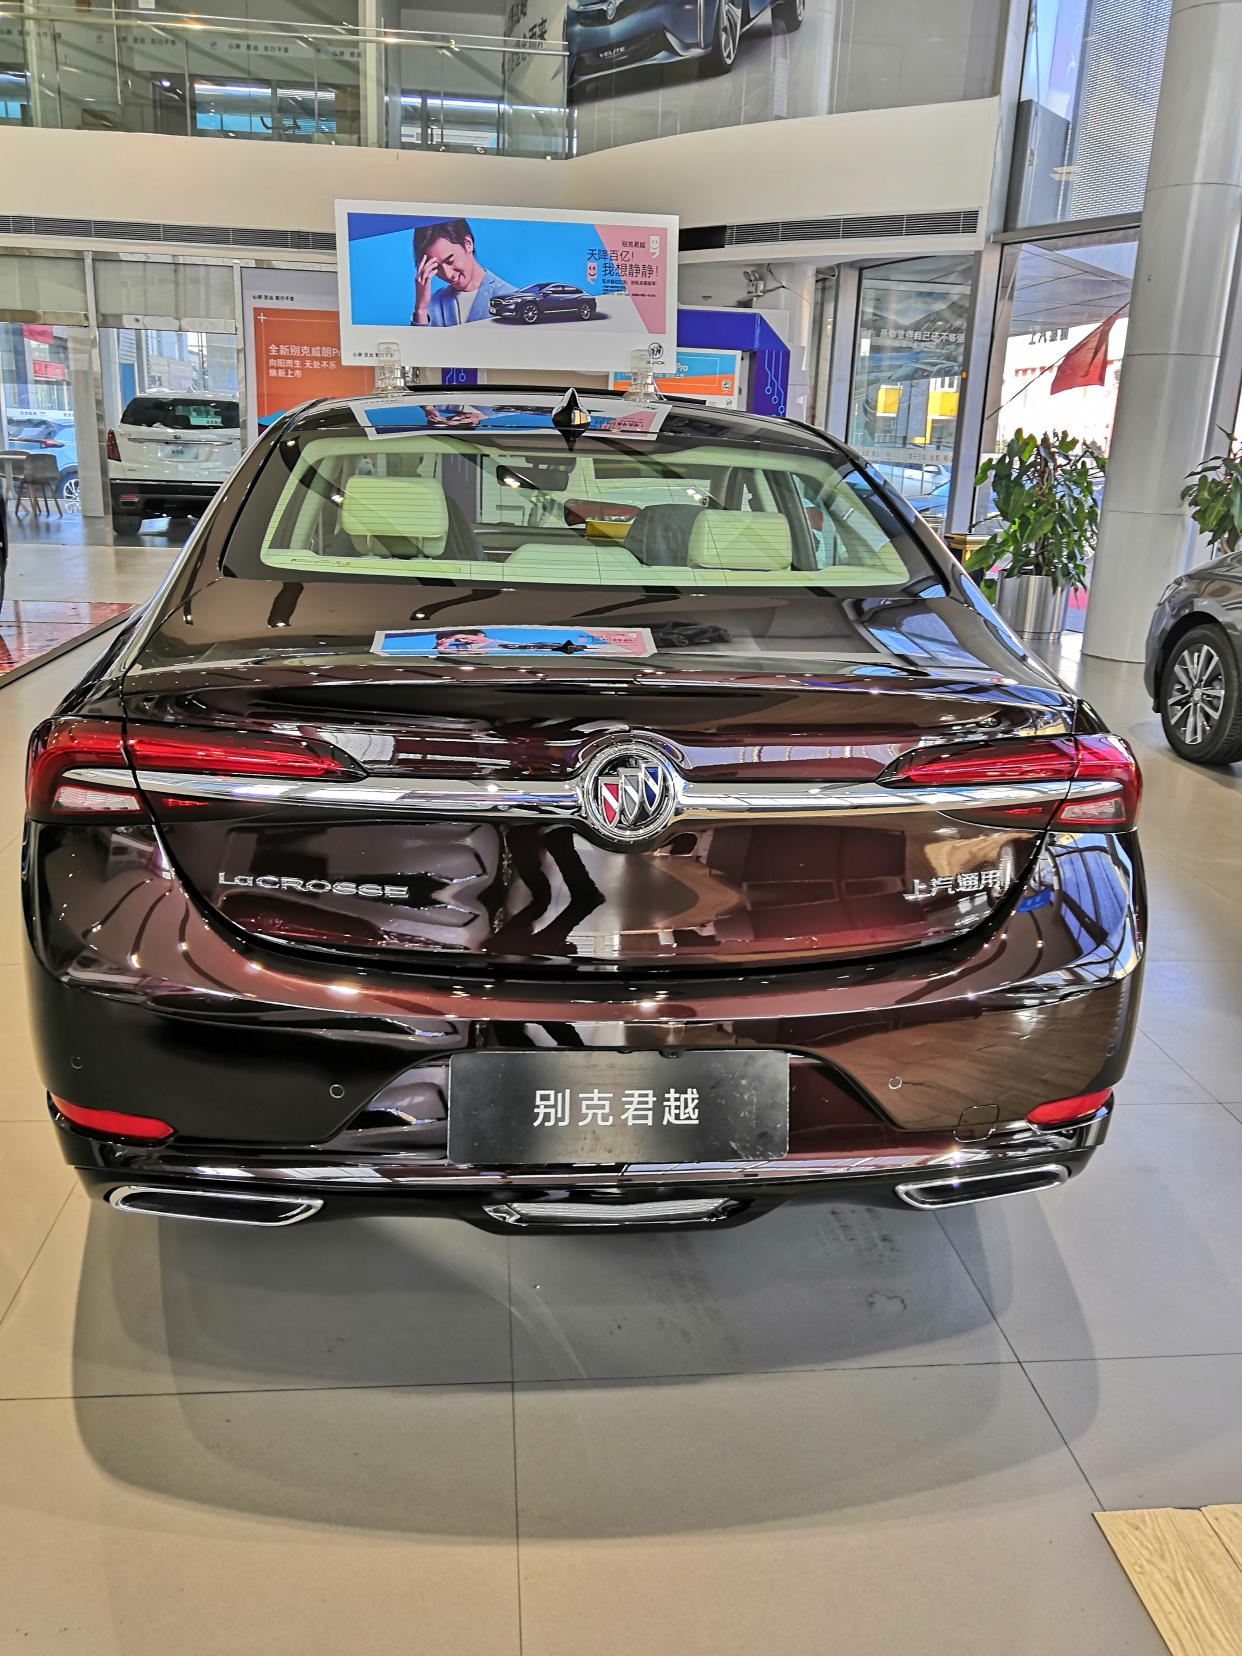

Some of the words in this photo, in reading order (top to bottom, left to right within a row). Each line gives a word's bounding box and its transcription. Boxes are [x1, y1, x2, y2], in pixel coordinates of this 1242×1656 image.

[599, 46, 626, 58] VELITE
[621, 240, 646, 248] 别克君越
[587, 248, 634, 262] 天降百亿!
[602, 262, 659, 279] 我想静静!
[268, 358, 302, 369] 向阳而生
[304, 360, 338, 370] 无处不乐
[268, 368, 302, 378] 焕新上市
[902, 869, 1004, 900] 上汽通用
[532, 1088, 699, 1127] 别克君越
